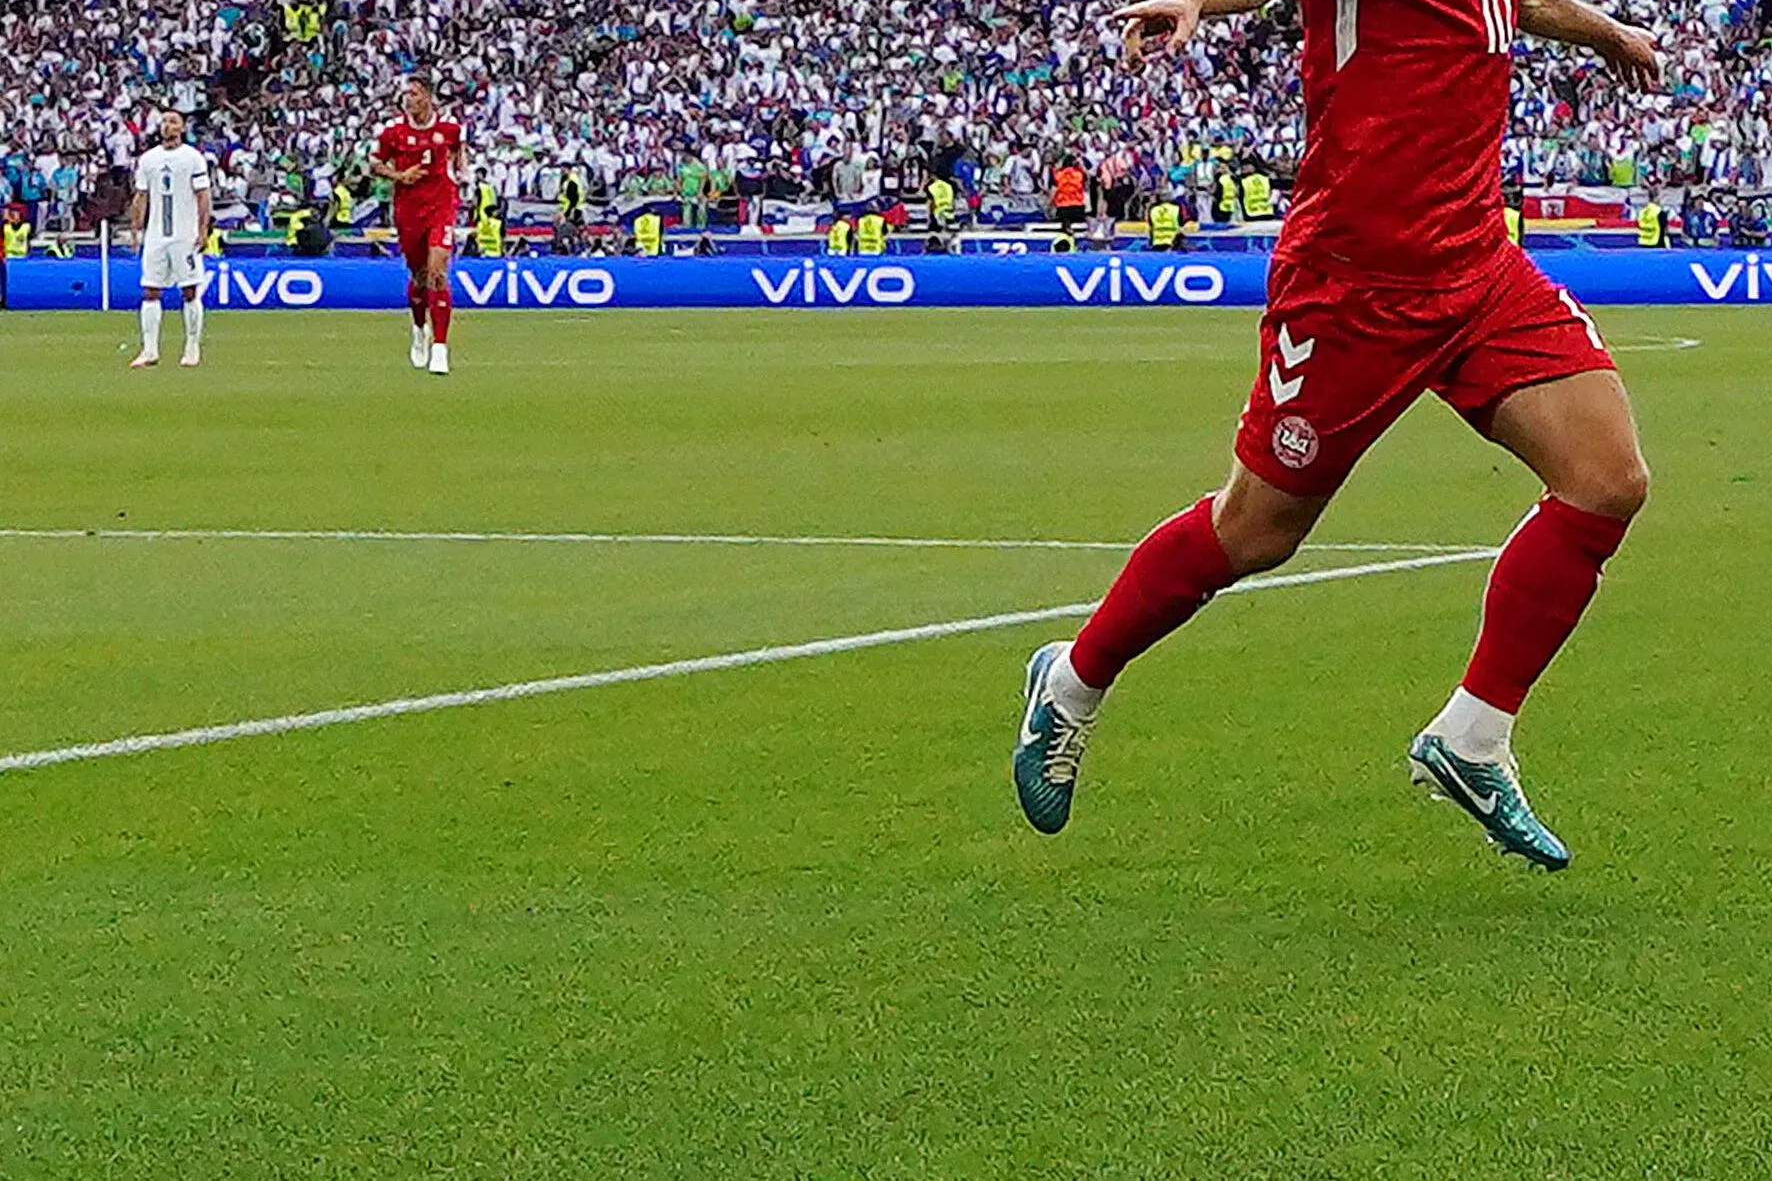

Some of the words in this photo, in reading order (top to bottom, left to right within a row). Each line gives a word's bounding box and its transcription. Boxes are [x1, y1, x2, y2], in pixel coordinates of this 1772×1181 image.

[456, 261, 615, 305] vivo
[751, 258, 916, 304] vivo
[1055, 257, 1225, 302] vivo
